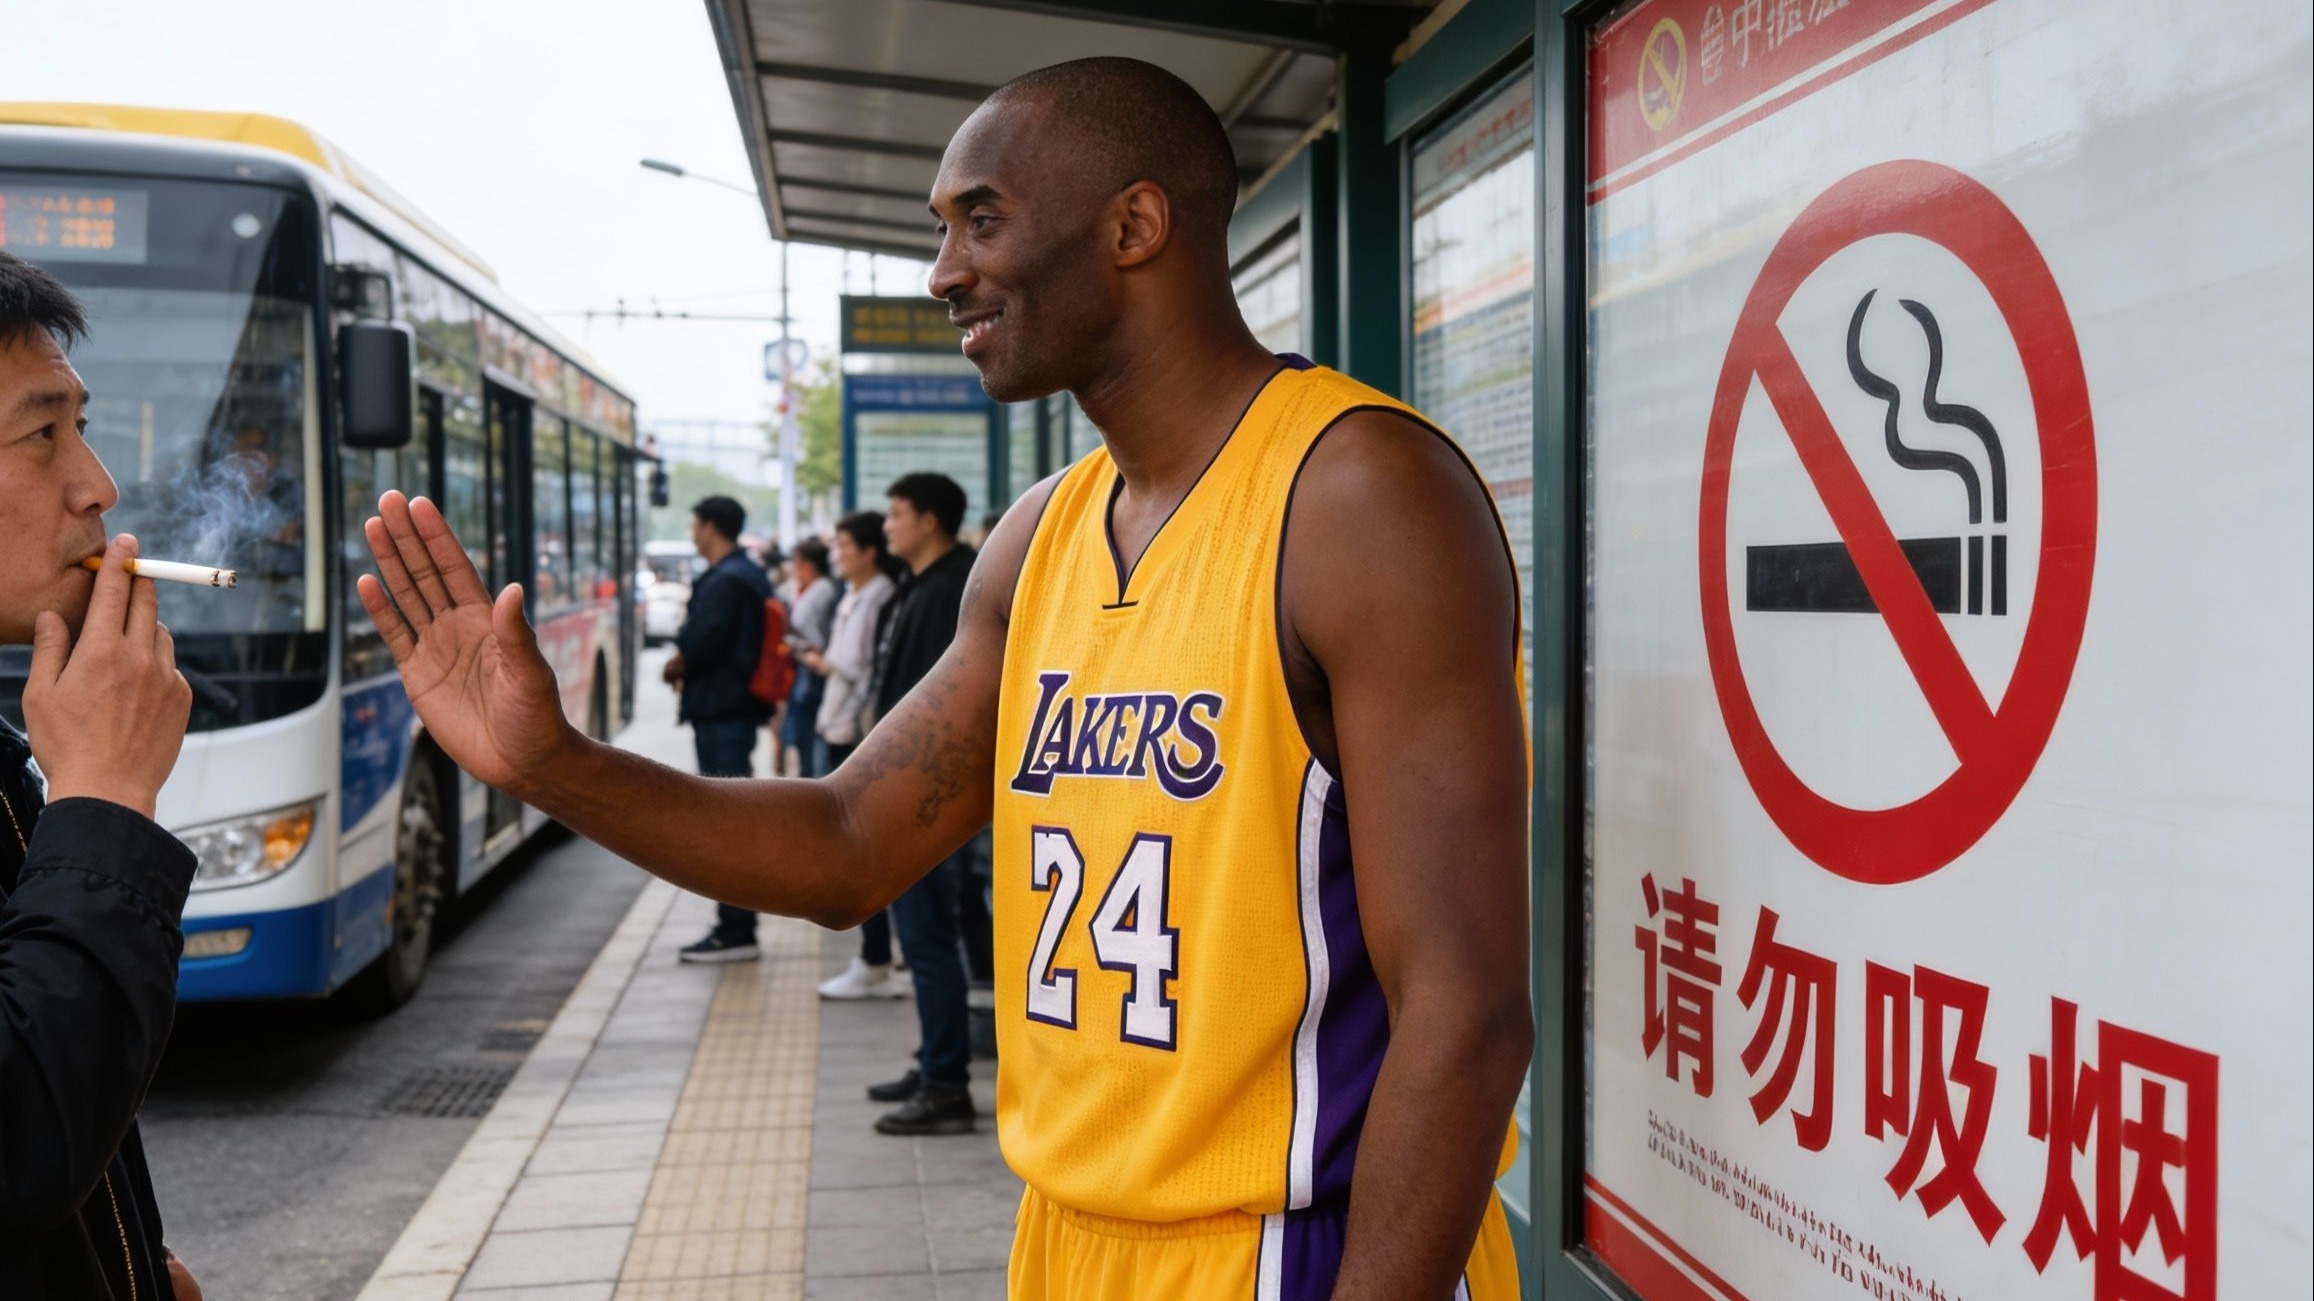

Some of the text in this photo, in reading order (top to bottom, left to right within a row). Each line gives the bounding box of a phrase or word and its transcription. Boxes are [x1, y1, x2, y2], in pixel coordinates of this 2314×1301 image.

[1010, 669, 1226, 802] LAKERS
[1026, 825, 1180, 1051] 24
[1635, 872, 2220, 1301] 请勿吸烟
